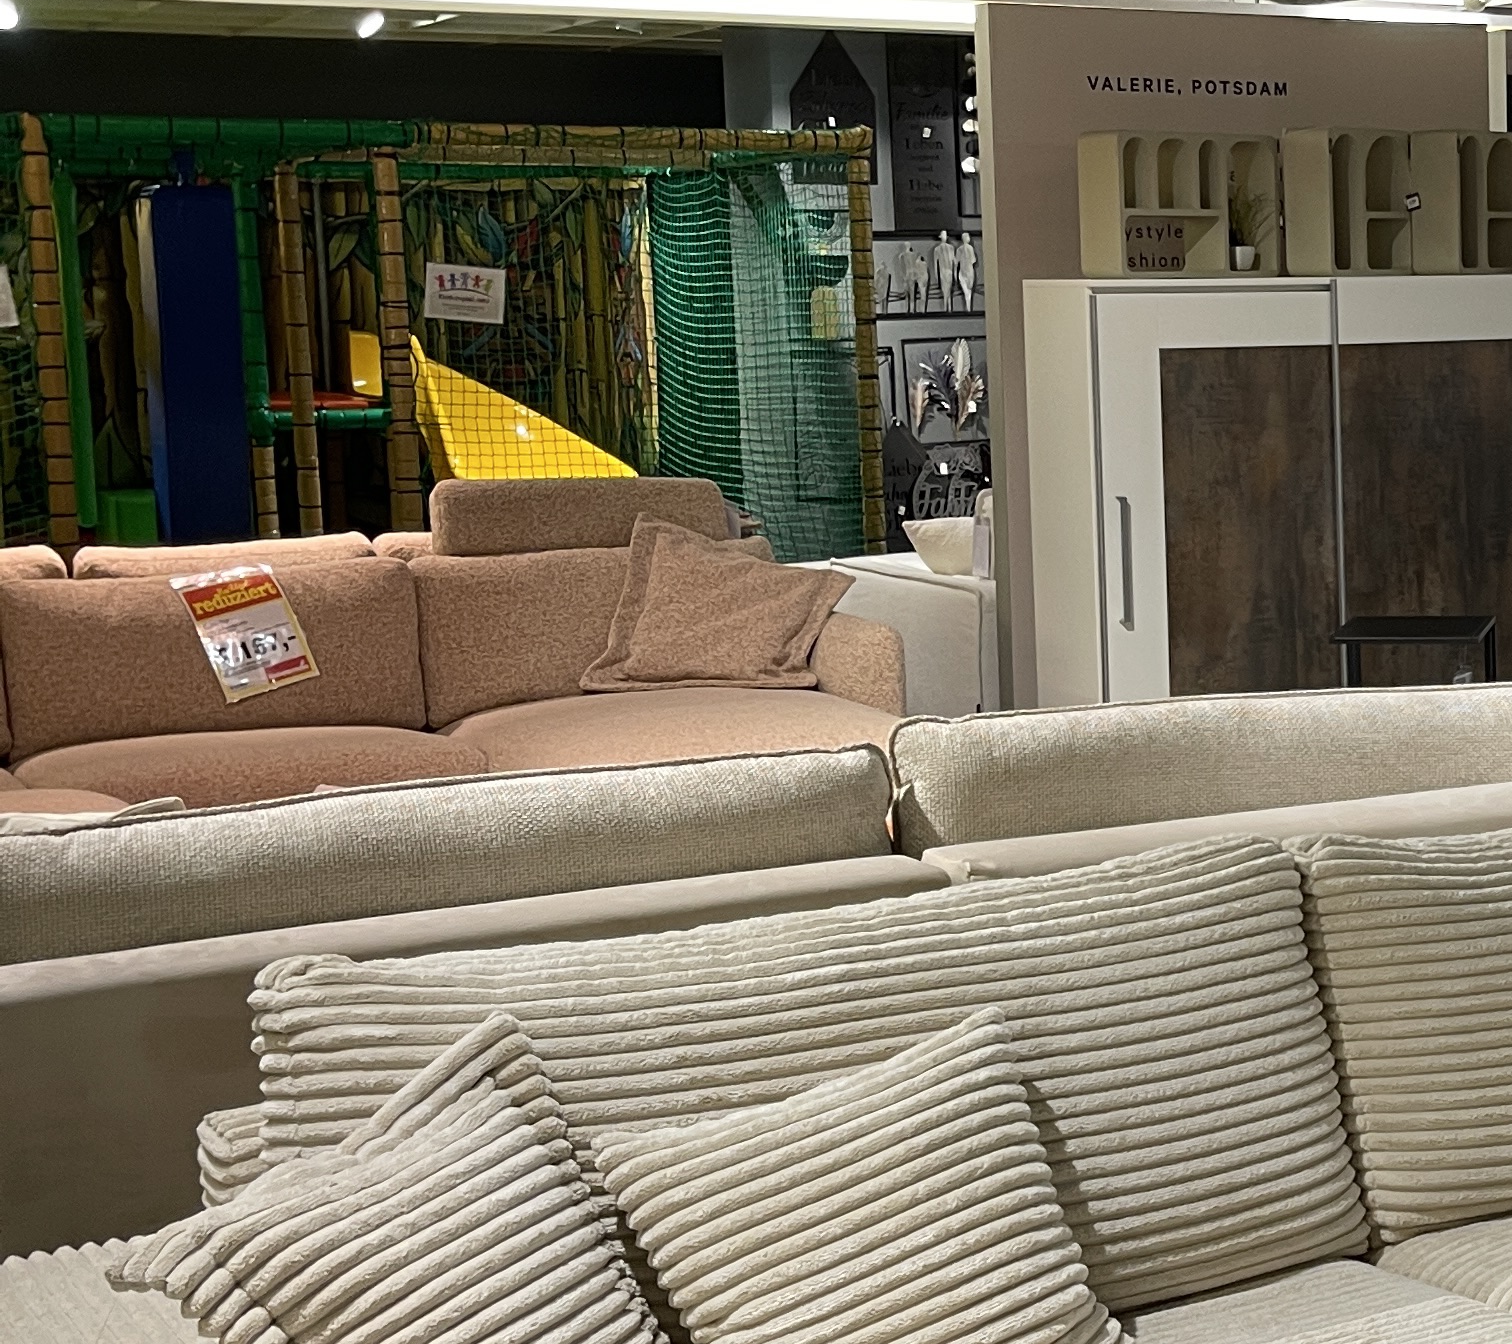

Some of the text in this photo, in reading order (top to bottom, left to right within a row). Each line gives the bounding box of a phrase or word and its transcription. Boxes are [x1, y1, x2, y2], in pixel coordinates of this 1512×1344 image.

[1087, 76, 1288, 96] VALERIE, POTSDAM
[1127, 253, 1186, 269] shion
[191, 581, 278, 615] reduziert
